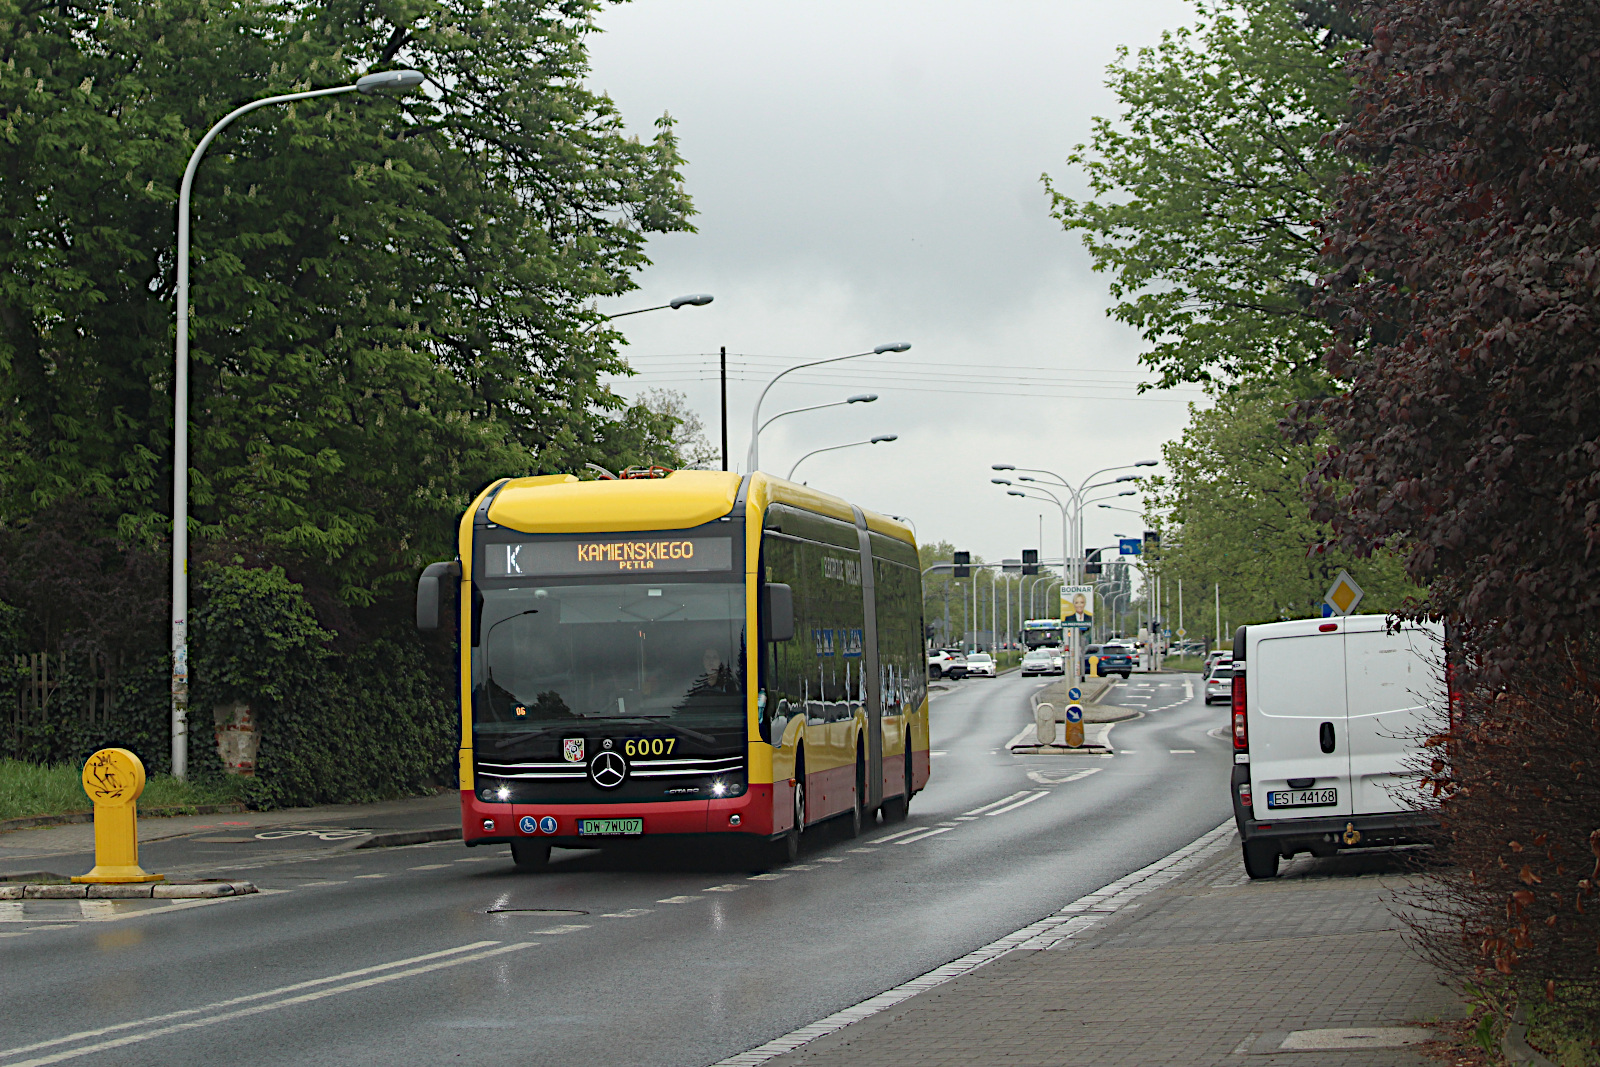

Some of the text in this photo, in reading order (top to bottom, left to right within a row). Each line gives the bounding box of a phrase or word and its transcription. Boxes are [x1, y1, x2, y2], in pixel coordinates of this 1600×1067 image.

[506, 541, 694, 573] K KAMIEŃSKIEGO
[619, 560, 654, 570] PĘTLA
[515, 706, 526, 716] 06
[625, 738, 676, 756] 6007
[1274, 792, 1294, 805] ESI
[1300, 790, 1335, 803] 44168
[586, 820, 640, 833] DW 7WU07
